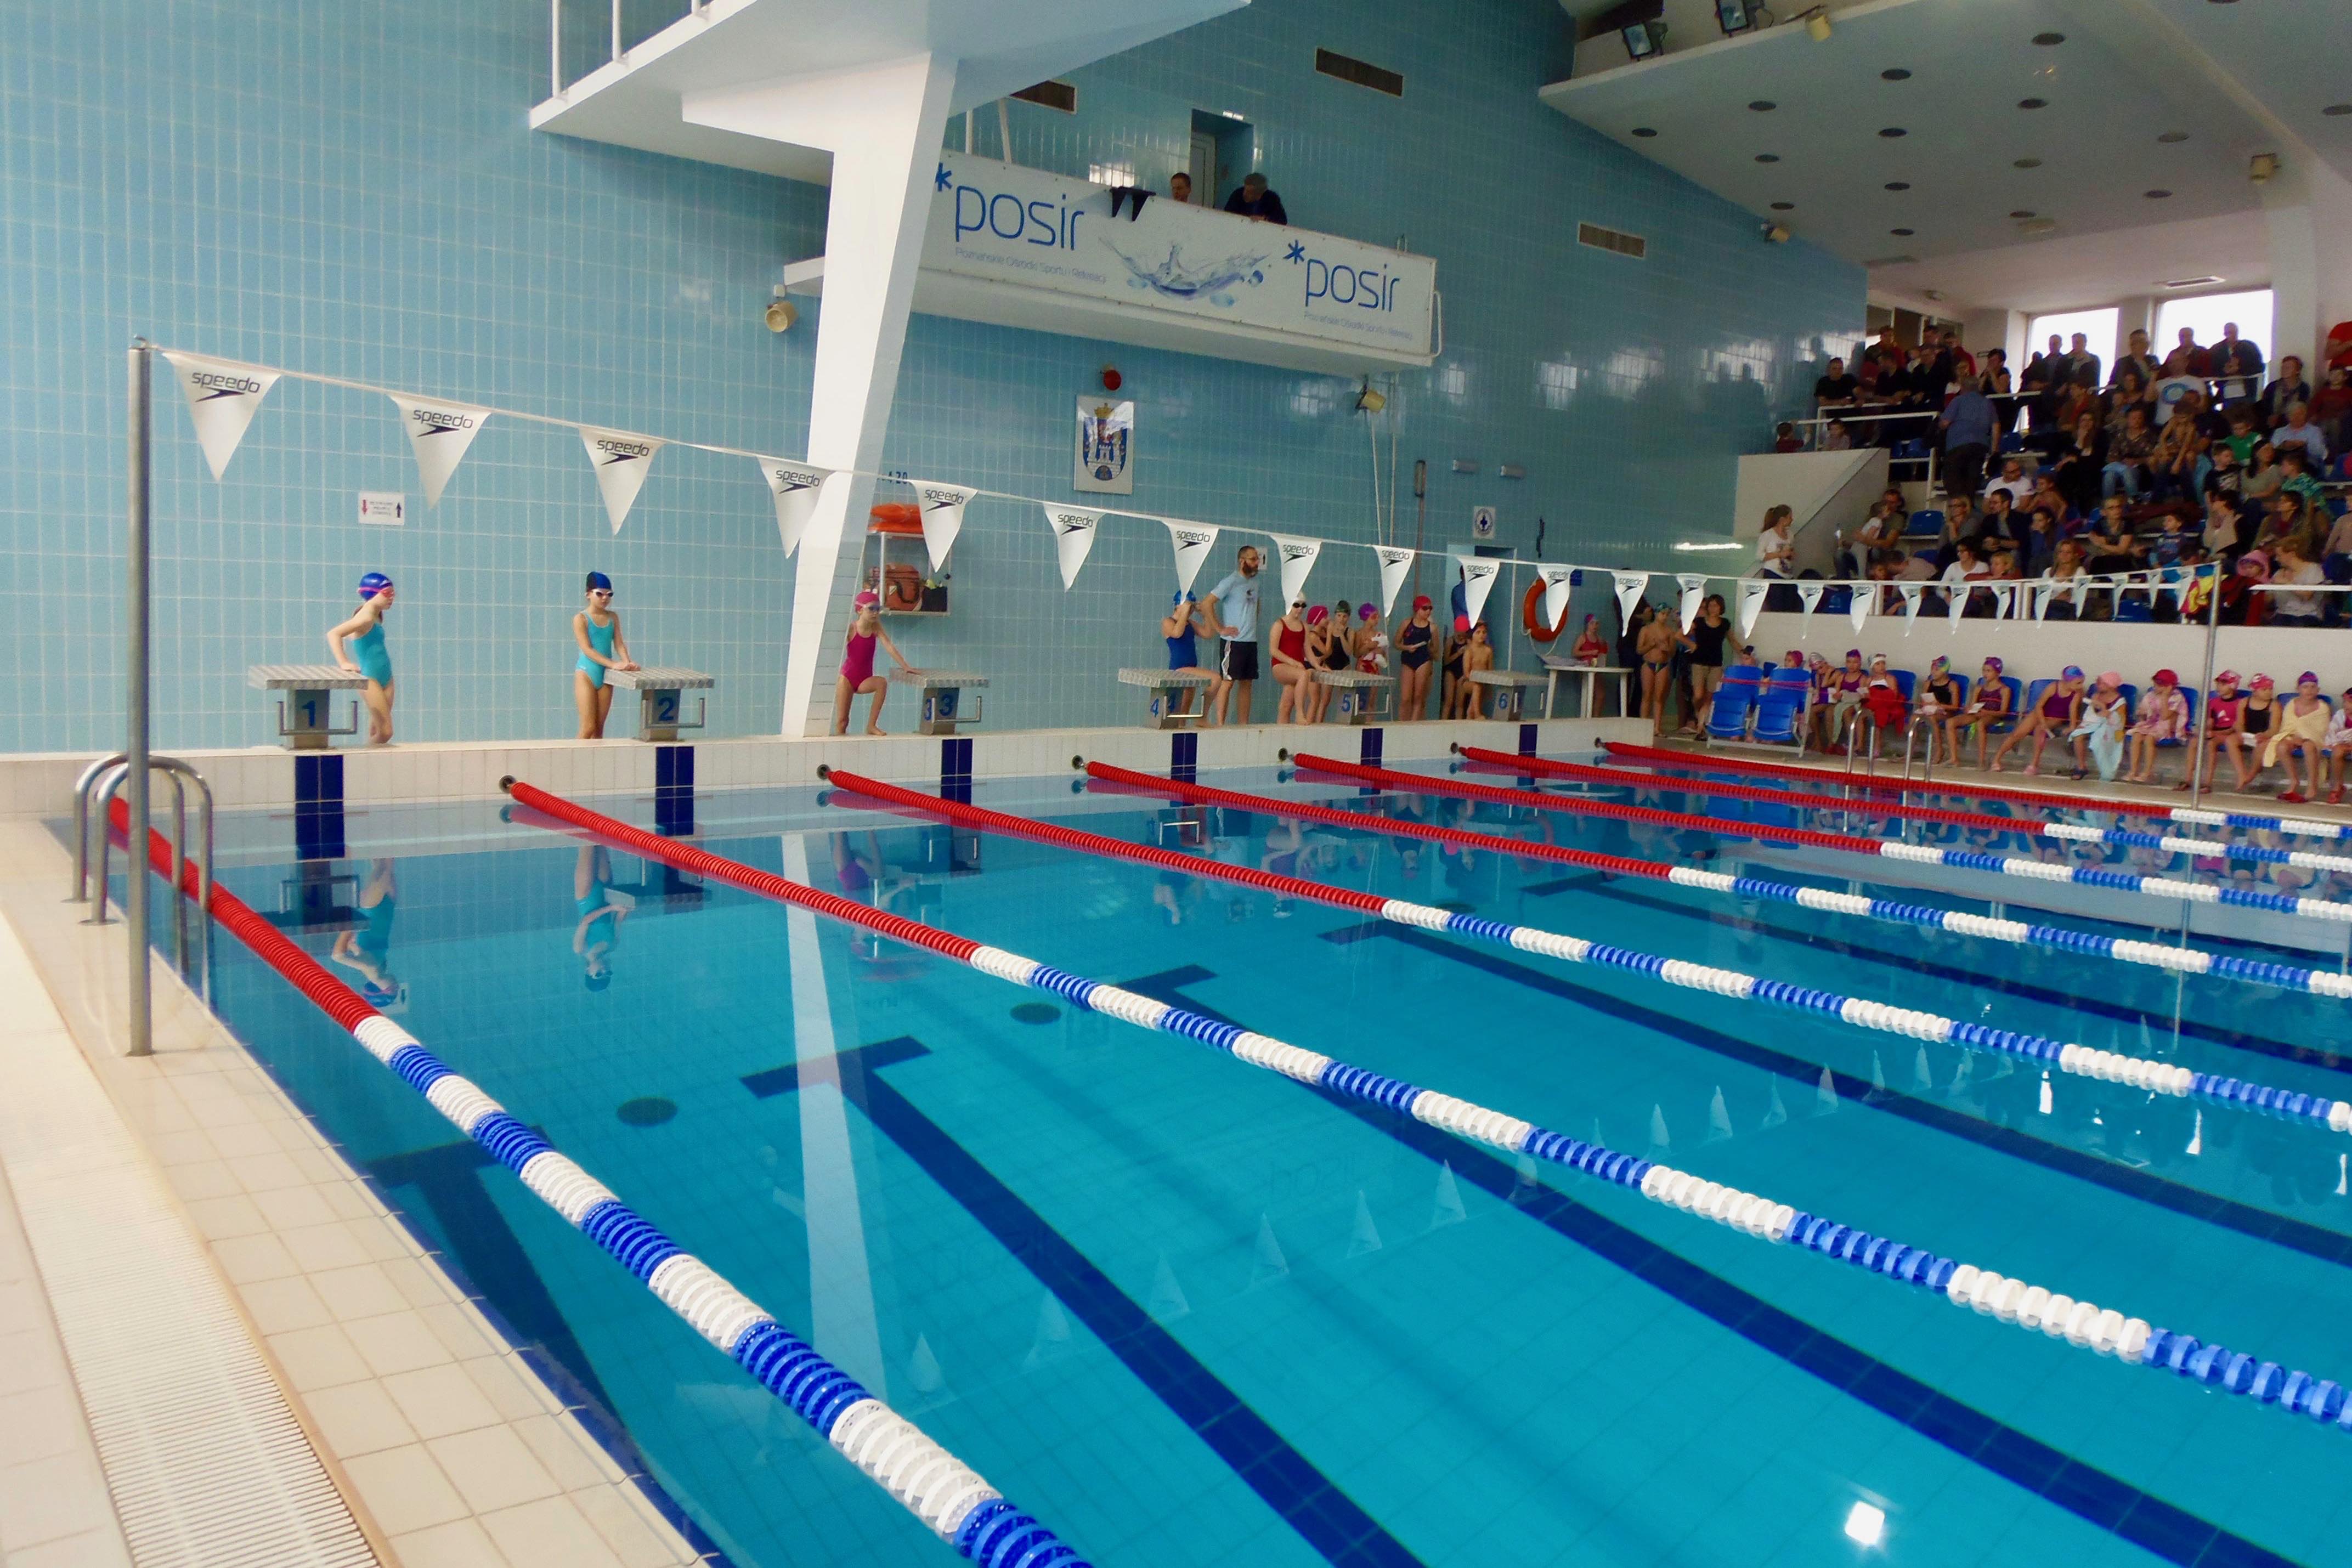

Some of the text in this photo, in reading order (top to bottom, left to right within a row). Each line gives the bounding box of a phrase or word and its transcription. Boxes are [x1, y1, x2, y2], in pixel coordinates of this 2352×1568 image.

[956, 185, 1085, 251] posir
[1305, 258, 1400, 313] posir
[191, 372, 260, 393] speedo
[412, 410, 473, 428] speedo
[596, 440, 649, 457] speedo
[776, 470, 820, 487] speedo
[924, 489, 964, 505] speedo
[1058, 514, 1093, 528] speedo
[1176, 530, 1211, 542] speedo
[1282, 545, 1314, 556] speedo
[1382, 550, 1410, 560] speedo
[1467, 565, 1494, 574] speedo
[1619, 578, 1644, 586] speedo
[658, 697, 674, 721] 2
[939, 693, 953, 716] 3
[1150, 698, 1160, 718] 4
[1342, 693, 1352, 712] 5
[1499, 692, 1508, 709] 6
[302, 700, 316, 727] 1
